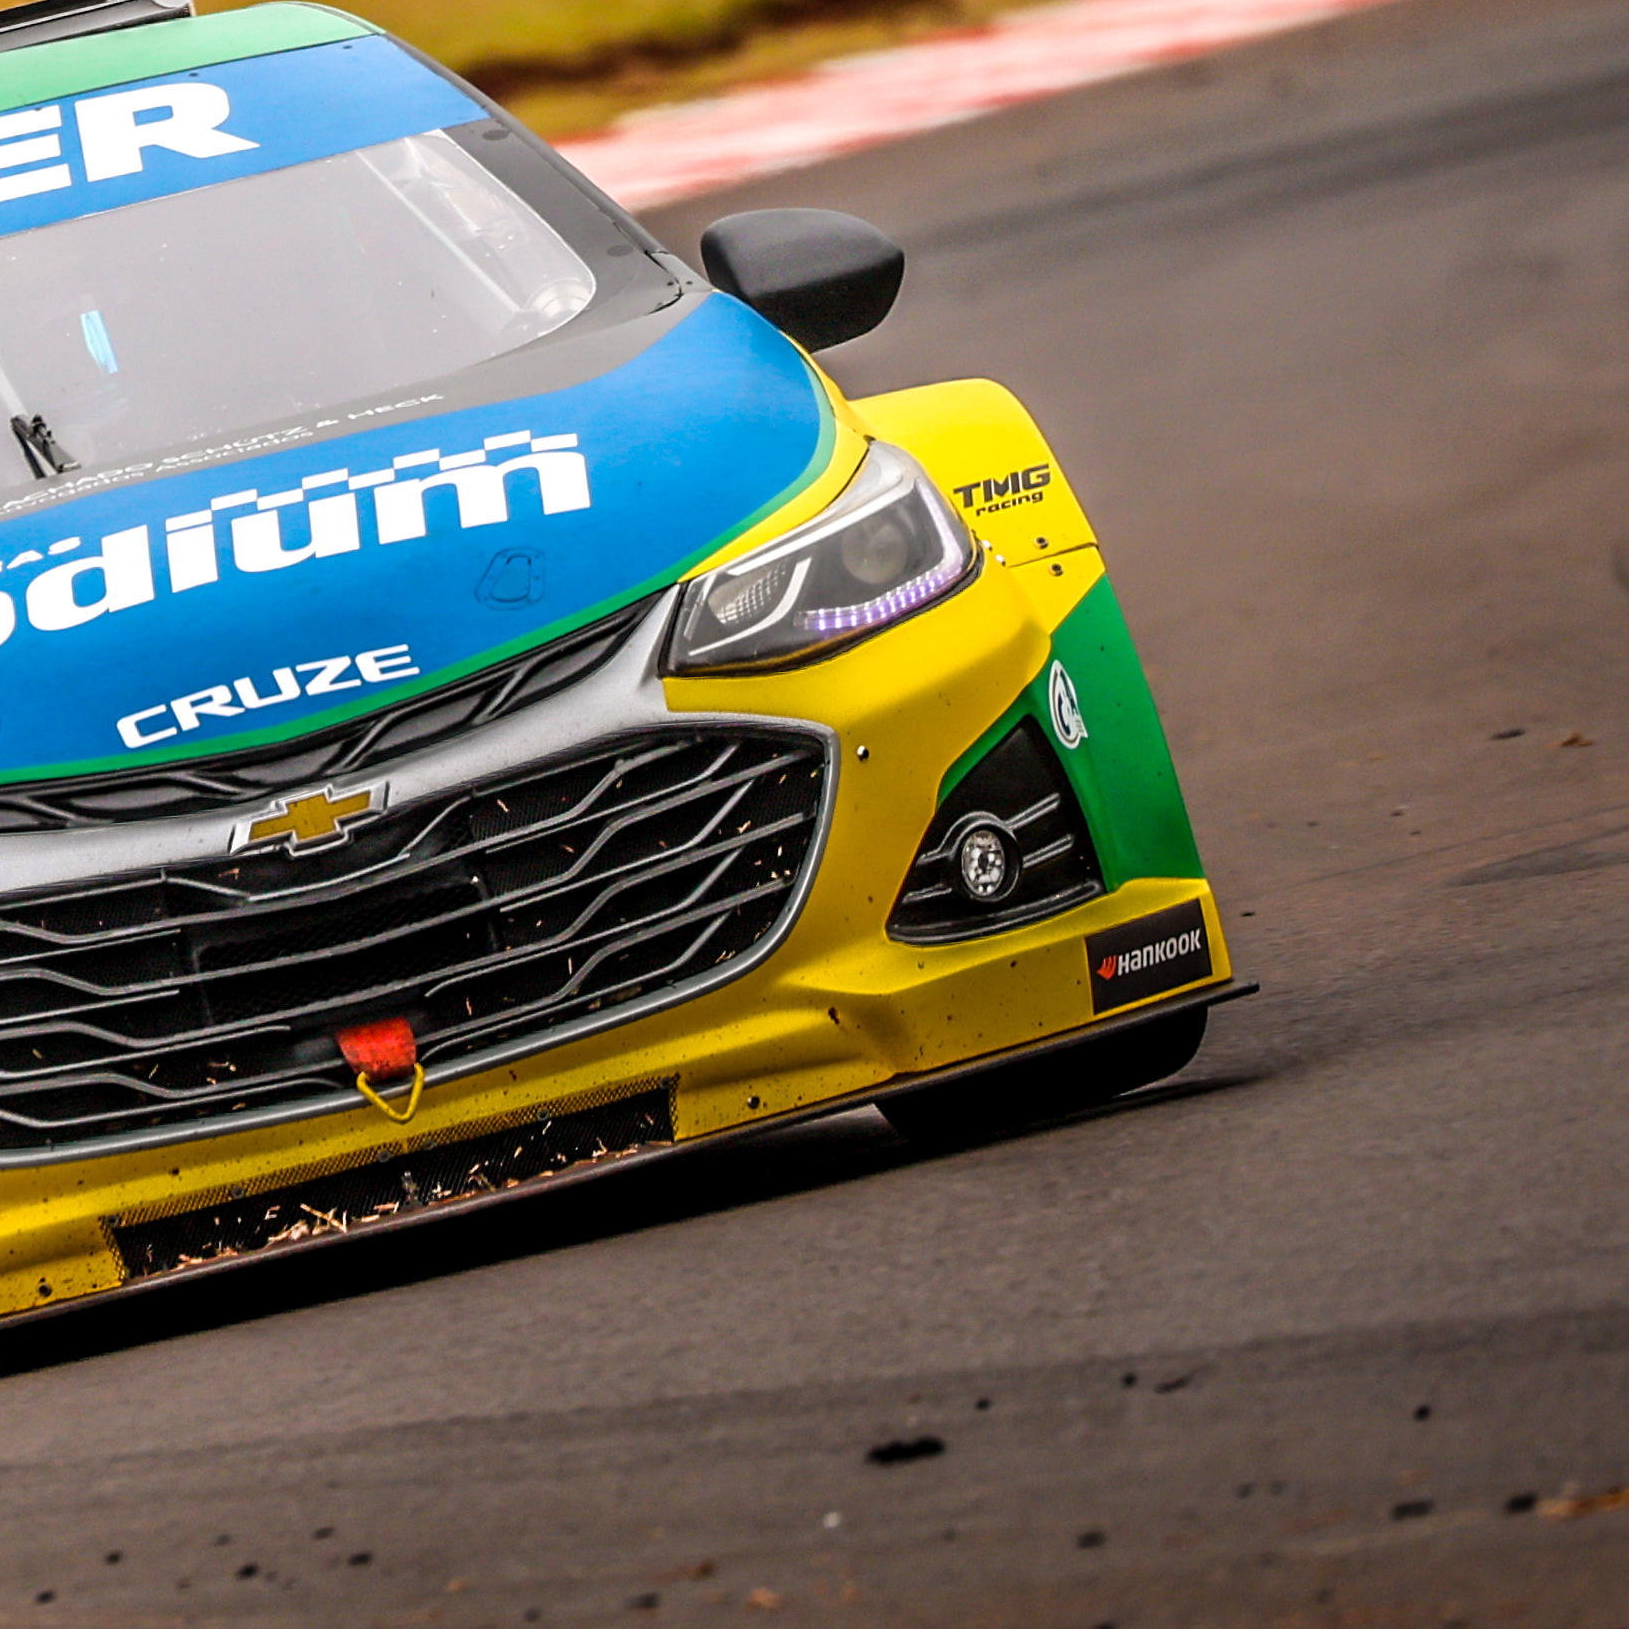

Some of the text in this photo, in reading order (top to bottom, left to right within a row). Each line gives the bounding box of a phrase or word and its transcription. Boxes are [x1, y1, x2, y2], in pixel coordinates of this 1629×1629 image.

[315, 418, 340, 429] &
[347, 393, 445, 421] HECK
[952, 463, 1051, 510] TMG
[975, 490, 1045, 517] racing
[116, 644, 421, 749] CRUZE
